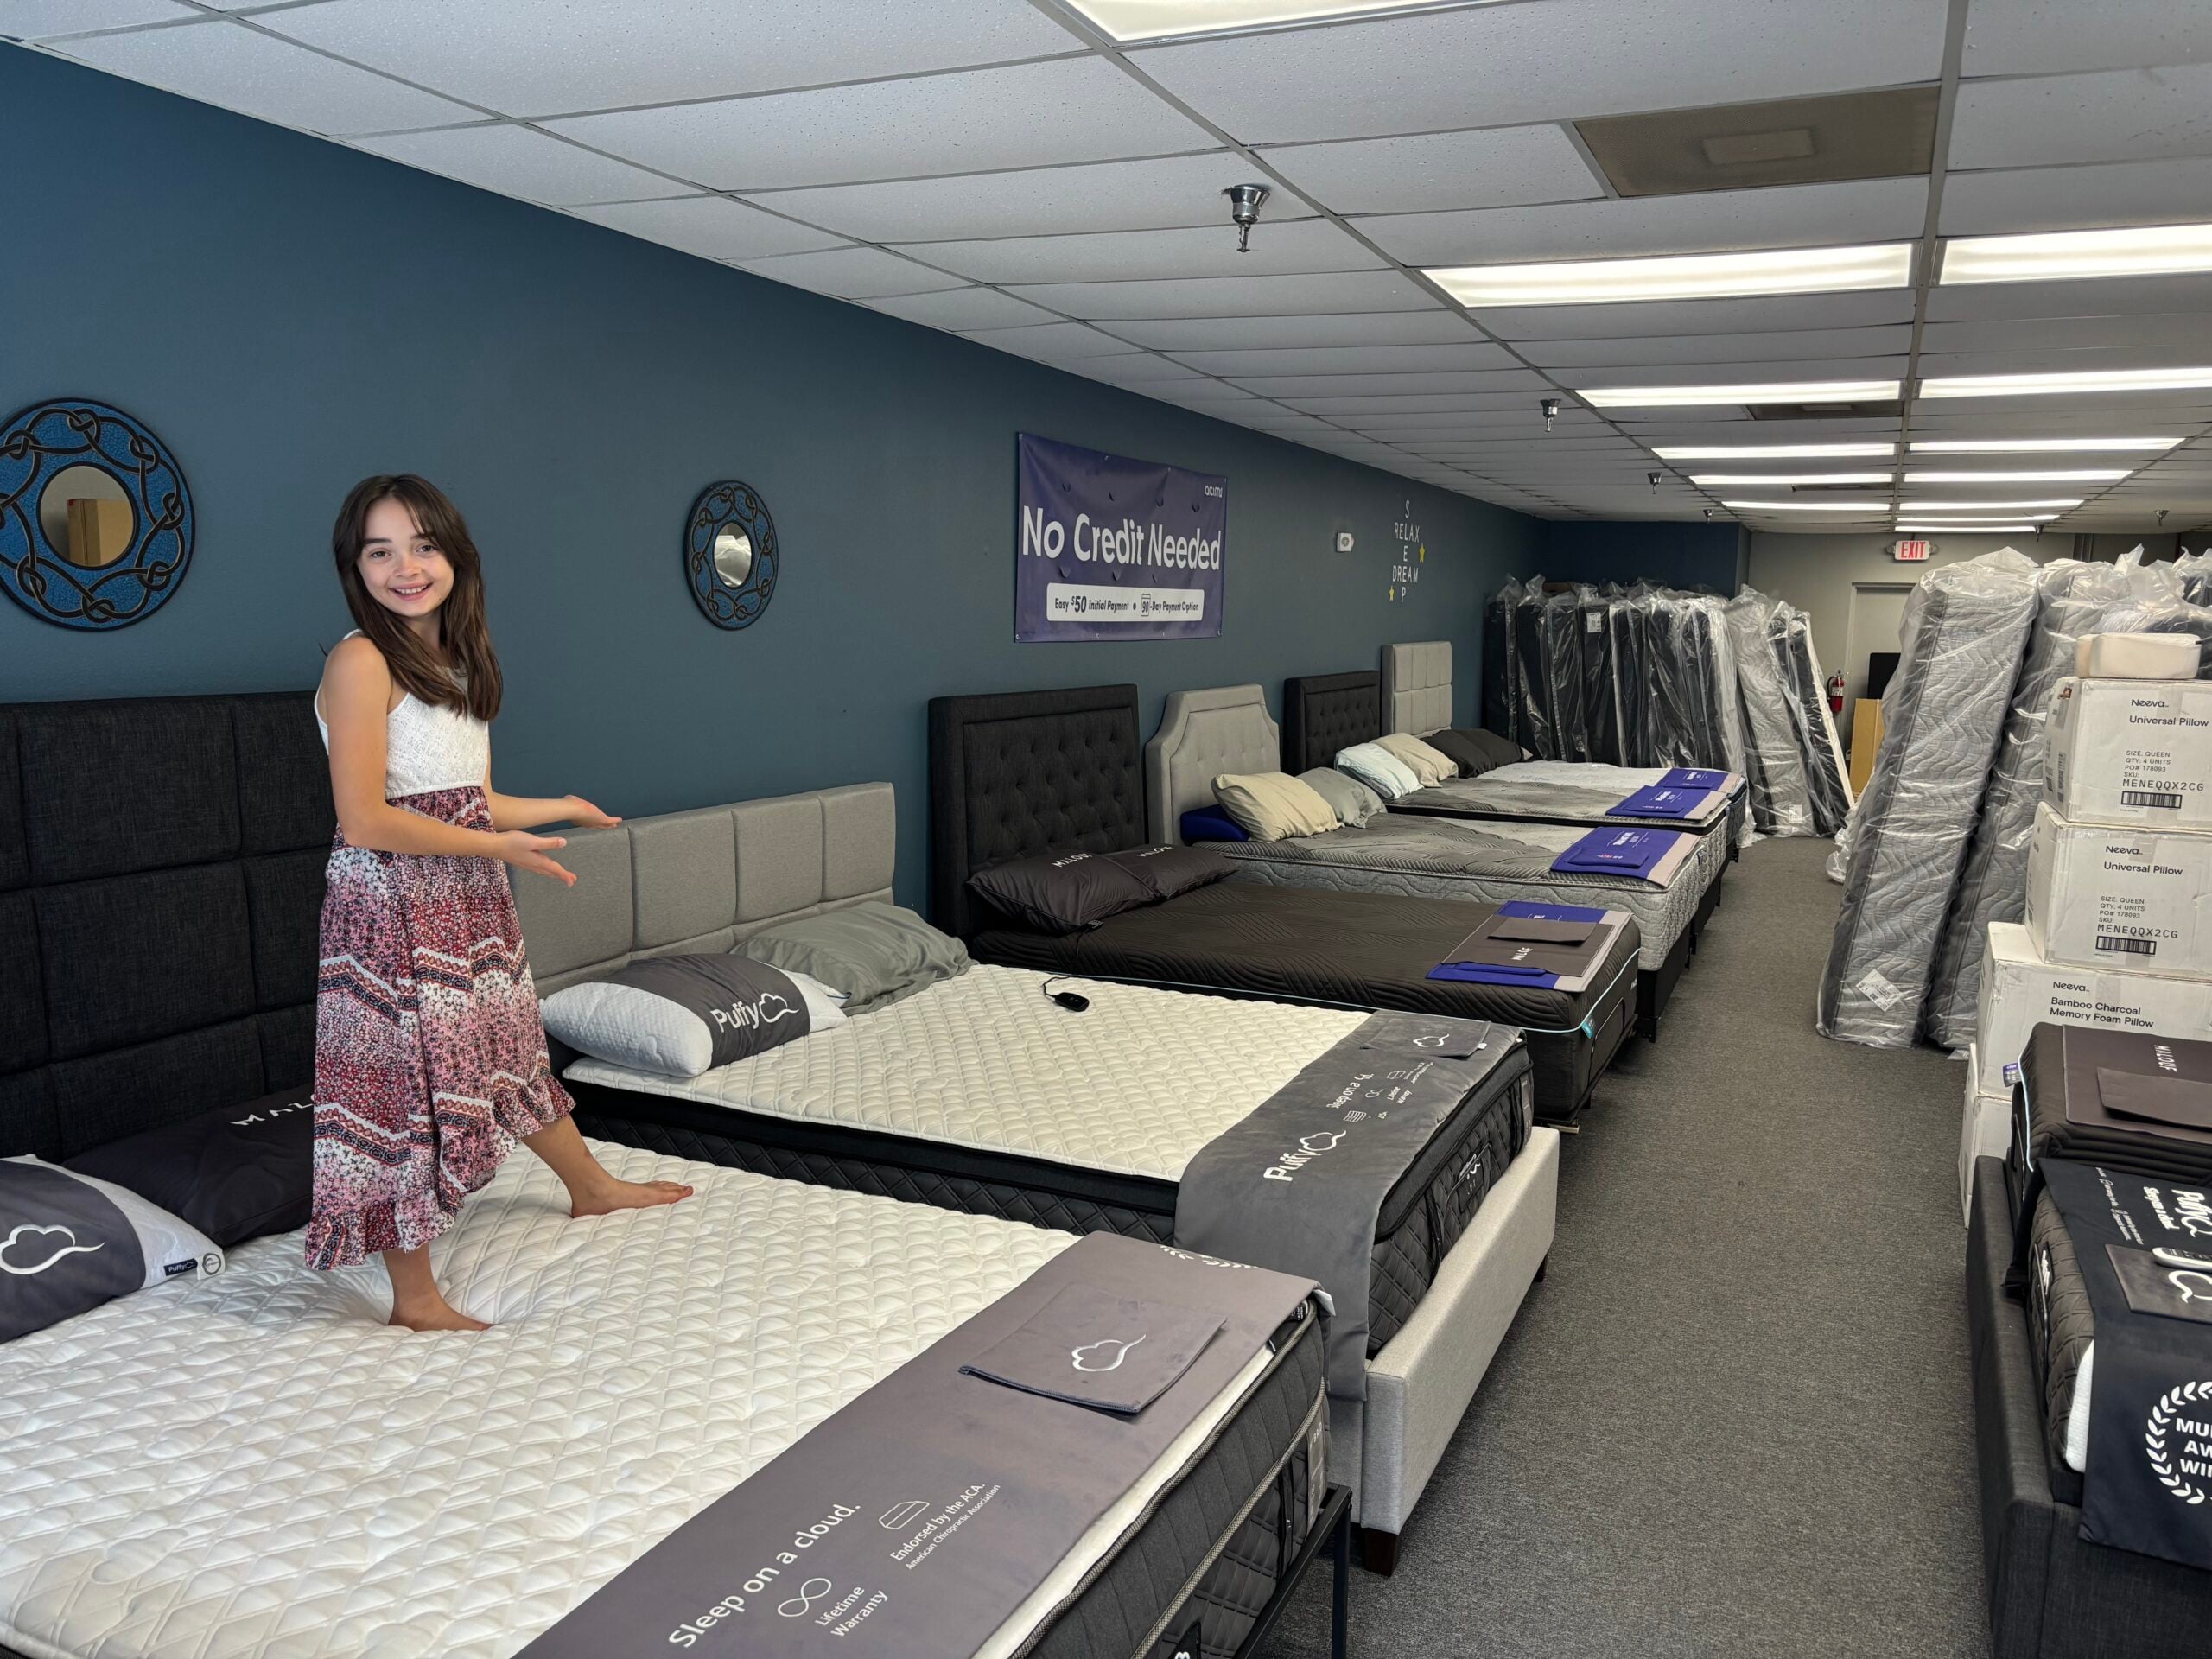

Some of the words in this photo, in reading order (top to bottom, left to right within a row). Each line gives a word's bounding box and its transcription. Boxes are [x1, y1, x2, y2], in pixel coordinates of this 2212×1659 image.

[1023, 505, 1065, 558] No
[1073, 513, 1144, 565] Credit
[1147, 524, 1221, 570] Needed
[1394, 522, 1420, 543] RELAX
[1901, 542, 1926, 558] EXIT
[1392, 565, 1419, 583] DREAM
[1054, 598, 1069, 613] Easy
[1071, 595, 1087, 613] $50
[1089, 599, 1106, 610] Initial
[1107, 600, 1129, 613] Payment
[1162, 601, 1181, 613] Payment
[1182, 602, 1199, 614] Option
[2129, 715, 2176, 726] Universal
[2179, 717, 2209, 727] Pillow
[2122, 779, 2204, 791] MENEQQX2CG
[2104, 861, 2151, 873] Universal
[2153, 865, 2183, 875] Pillow
[2097, 924, 2178, 938] MENEQQX2CG
[709, 999, 760, 1033] Puffy
[2050, 996, 2093, 1010] Bamboo
[2095, 1002, 2141, 1015] Charcoal
[2050, 1007, 2091, 1021] Memory
[2094, 1013, 2121, 1025] Foam
[2124, 1016, 2154, 1028] Pillow
[1263, 1148, 1322, 1182] Puffy
[168, 1262, 187, 1274] Puffy
[2176, 1418, 2212, 1439] MU
[890, 1522, 938, 1560] Endorsed
[931, 1514, 950, 1525] by
[944, 1501, 964, 1515] the
[960, 1484, 985, 1503] ACA.
[905, 1543, 938, 1569] American
[933, 1514, 970, 1543] Chiropractic
[967, 1484, 1001, 1515] Association
[668, 1593, 746, 1648] Sleep
[743, 1567, 781, 1593] on
[776, 1550, 798, 1565] a
[794, 1503, 861, 1549] cloud.
[815, 1585, 864, 1626] Lifetime
[830, 1589, 888, 1637] Warranty
